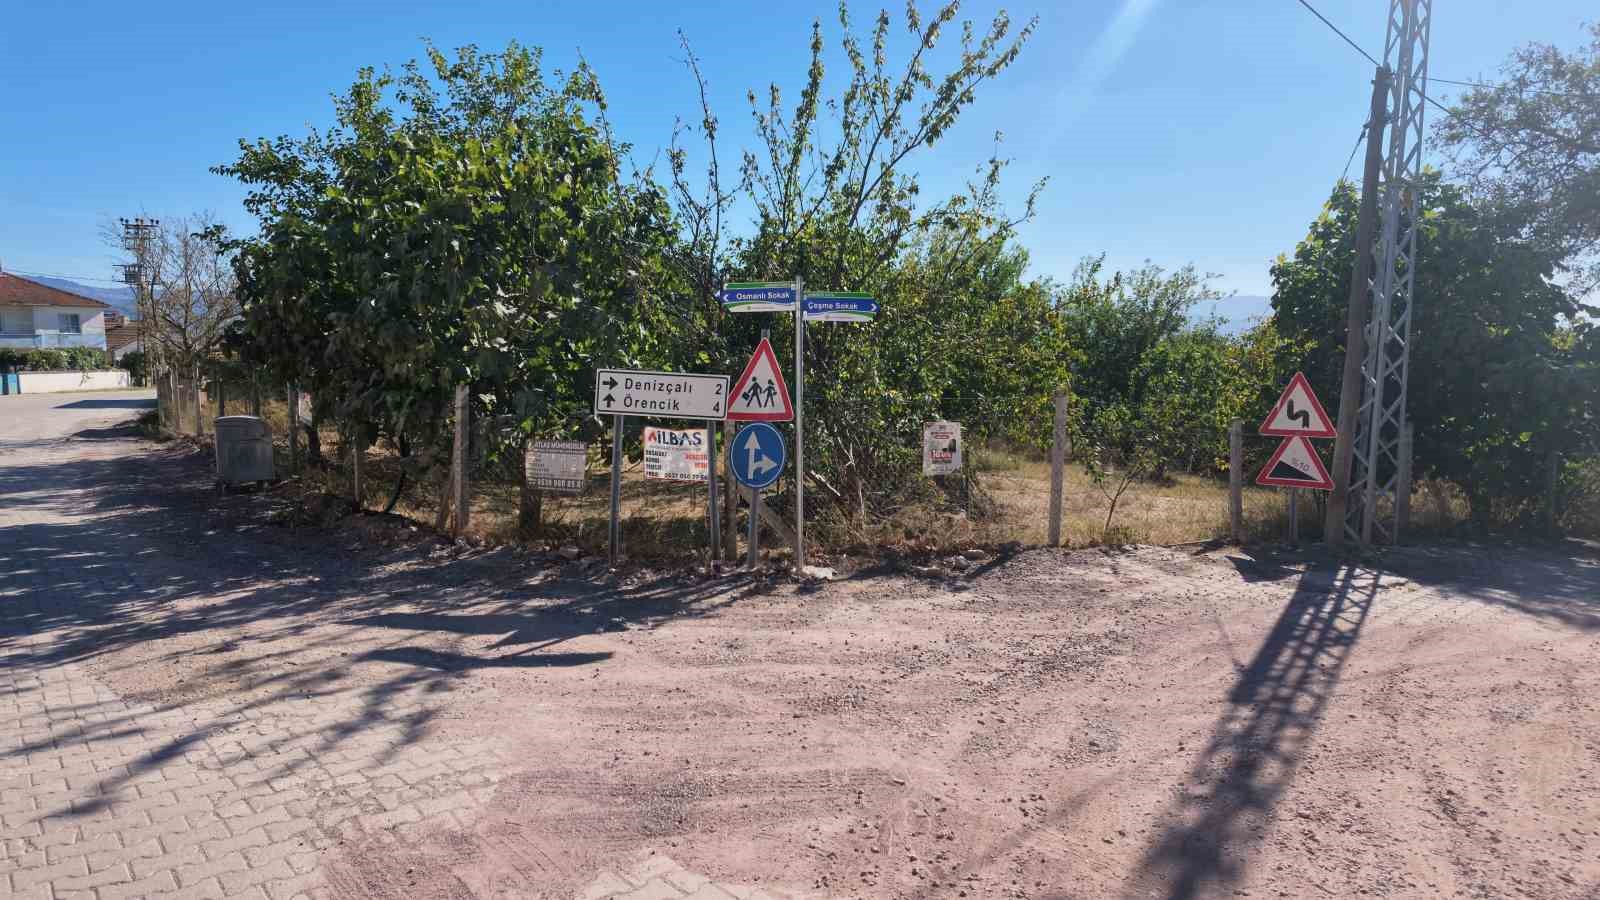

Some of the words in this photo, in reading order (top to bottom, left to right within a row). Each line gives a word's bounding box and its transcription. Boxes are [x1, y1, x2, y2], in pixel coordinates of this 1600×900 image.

[736, 292, 766, 300] Osmanlı
[767, 291, 790, 299] Sokak
[835, 303, 858, 311] Sokak
[624, 378, 692, 395] Denizçalı
[715, 384, 723, 395] 2
[623, 394, 680, 411] Örencik
[713, 401, 720, 413] 4
